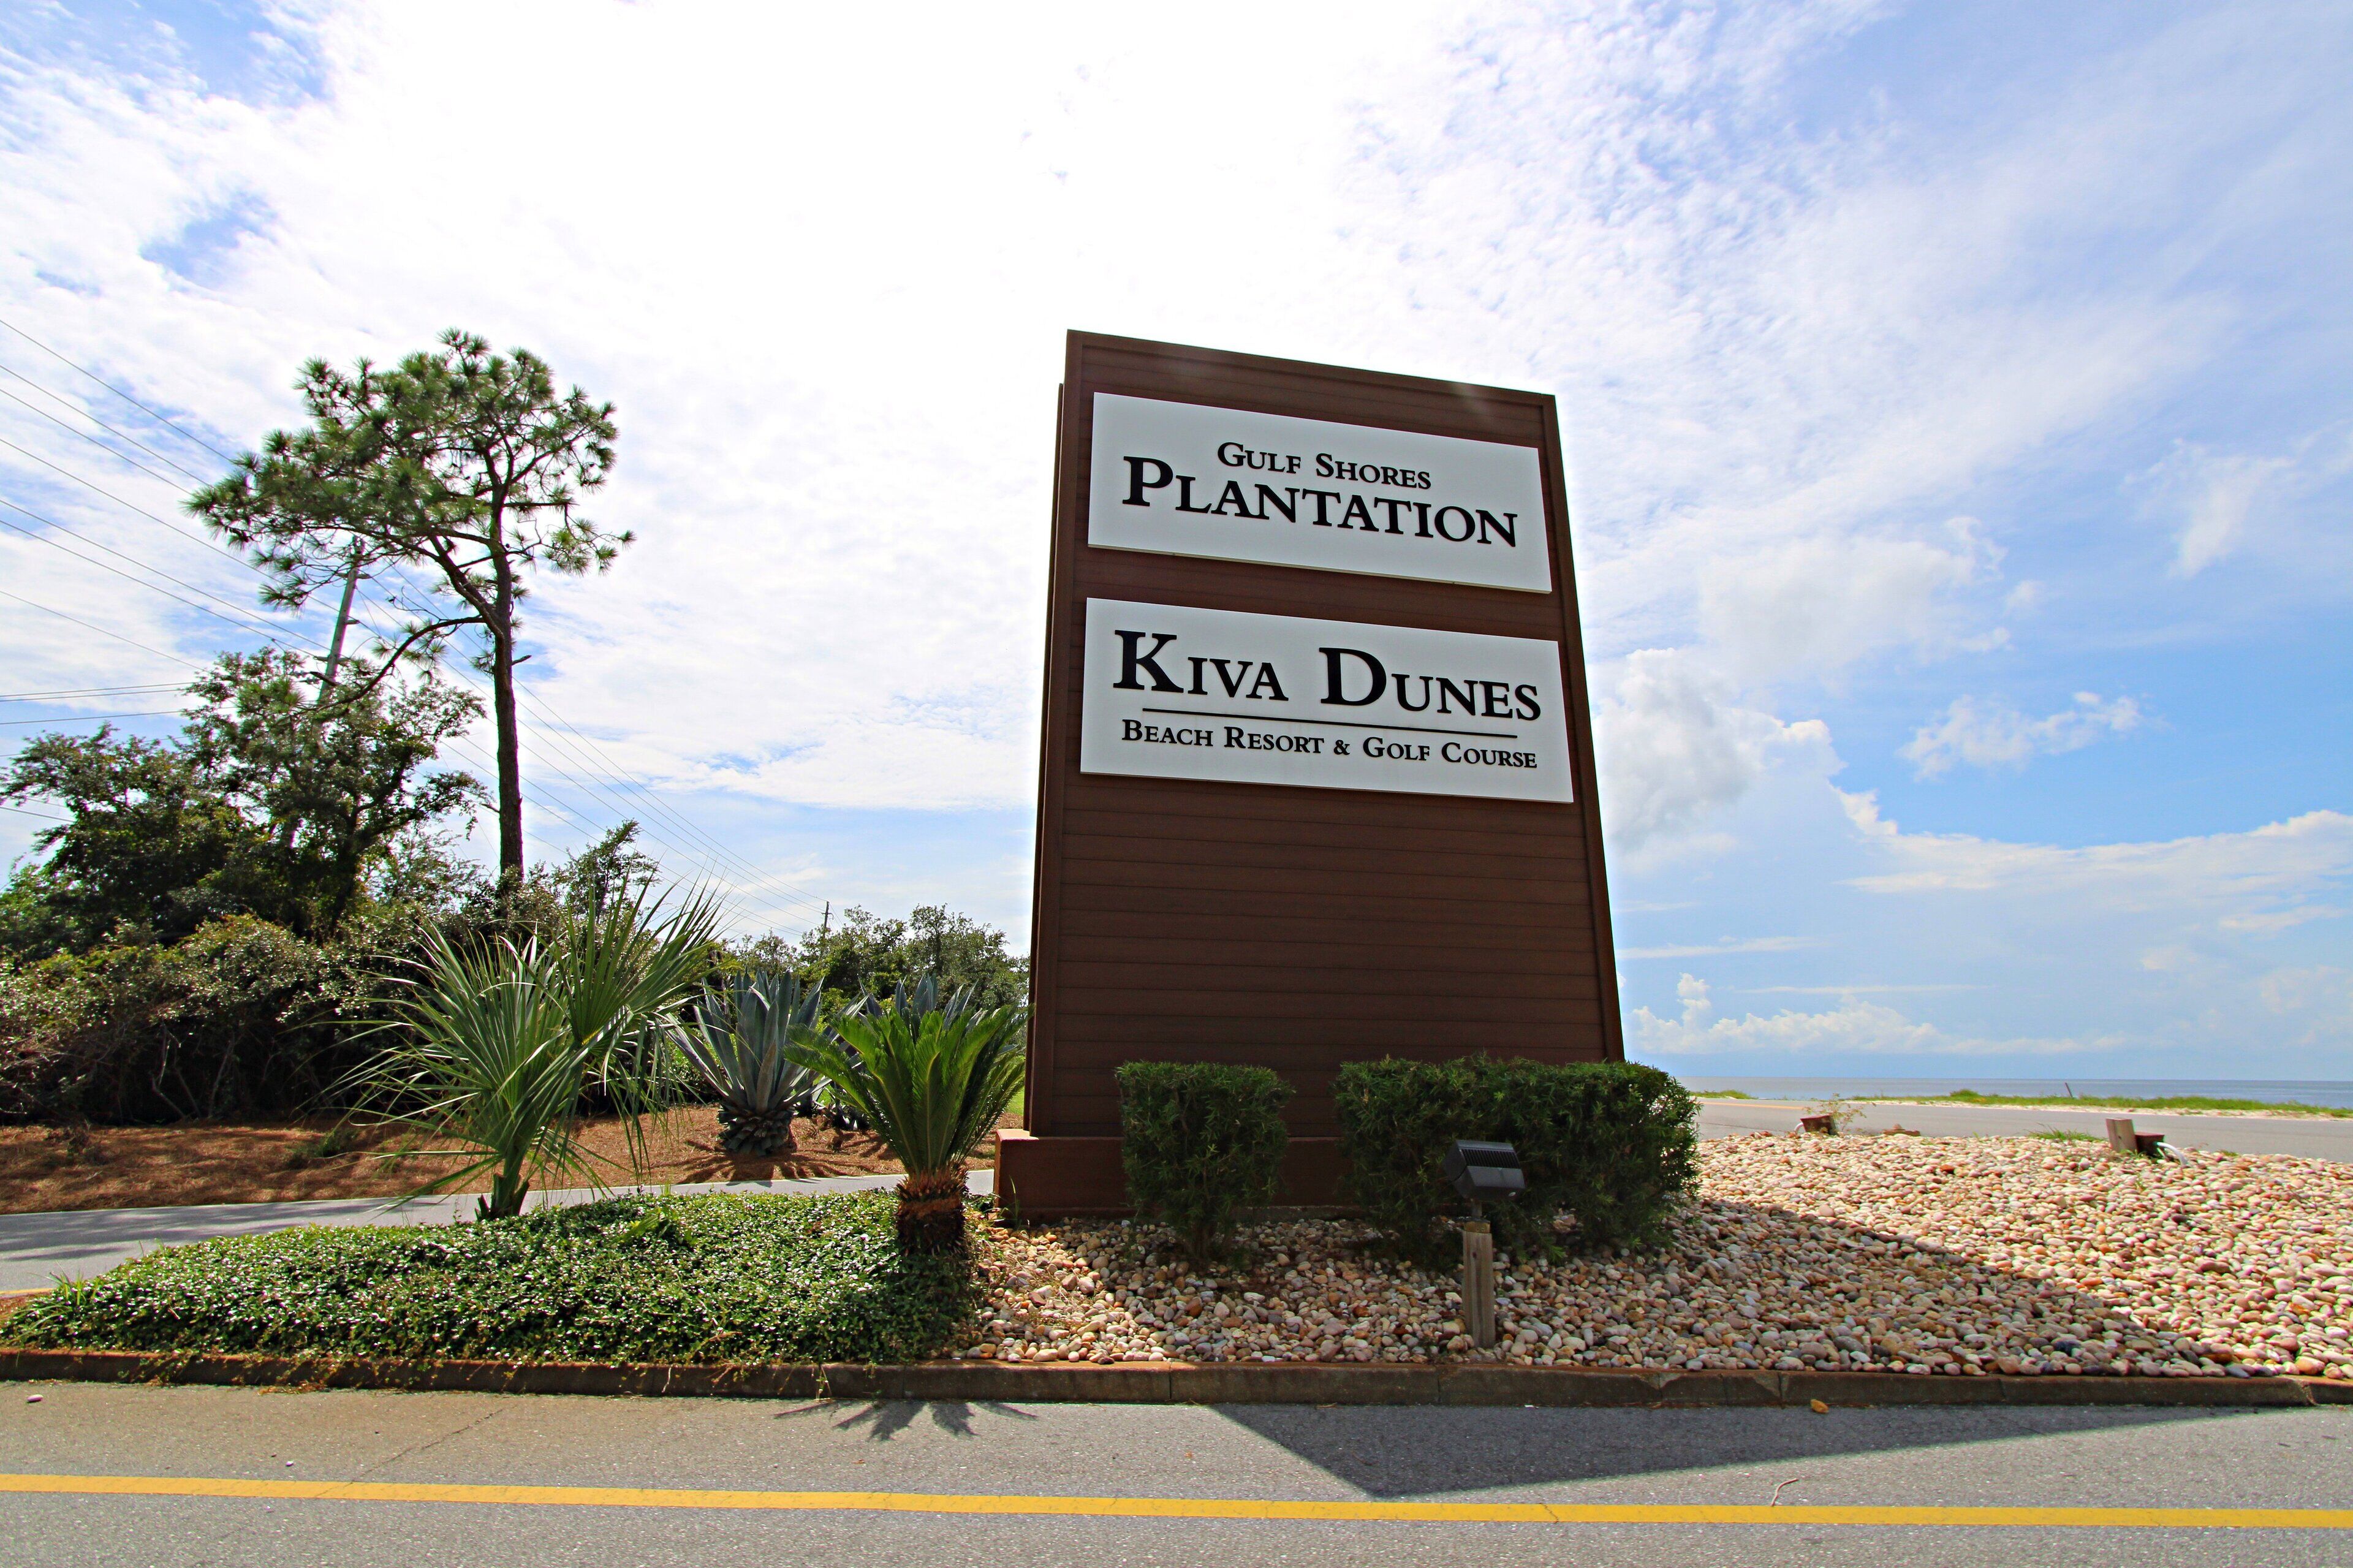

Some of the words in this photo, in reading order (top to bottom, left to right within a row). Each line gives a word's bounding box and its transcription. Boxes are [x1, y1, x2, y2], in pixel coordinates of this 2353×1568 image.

[1122, 455, 1518, 548] PLANTATION
[1217, 442, 1302, 474] GULF
[1316, 453, 1431, 490] SHORES
[1113, 629, 1289, 702] KIVA
[1318, 647, 1541, 721] DUNES
[1121, 719, 1214, 747] BEACH
[1224, 726, 1325, 754] RESORT
[1333, 739, 1351, 756] &
[1362, 737, 1430, 762] GOLF
[1441, 741, 1537, 769] COURSE
